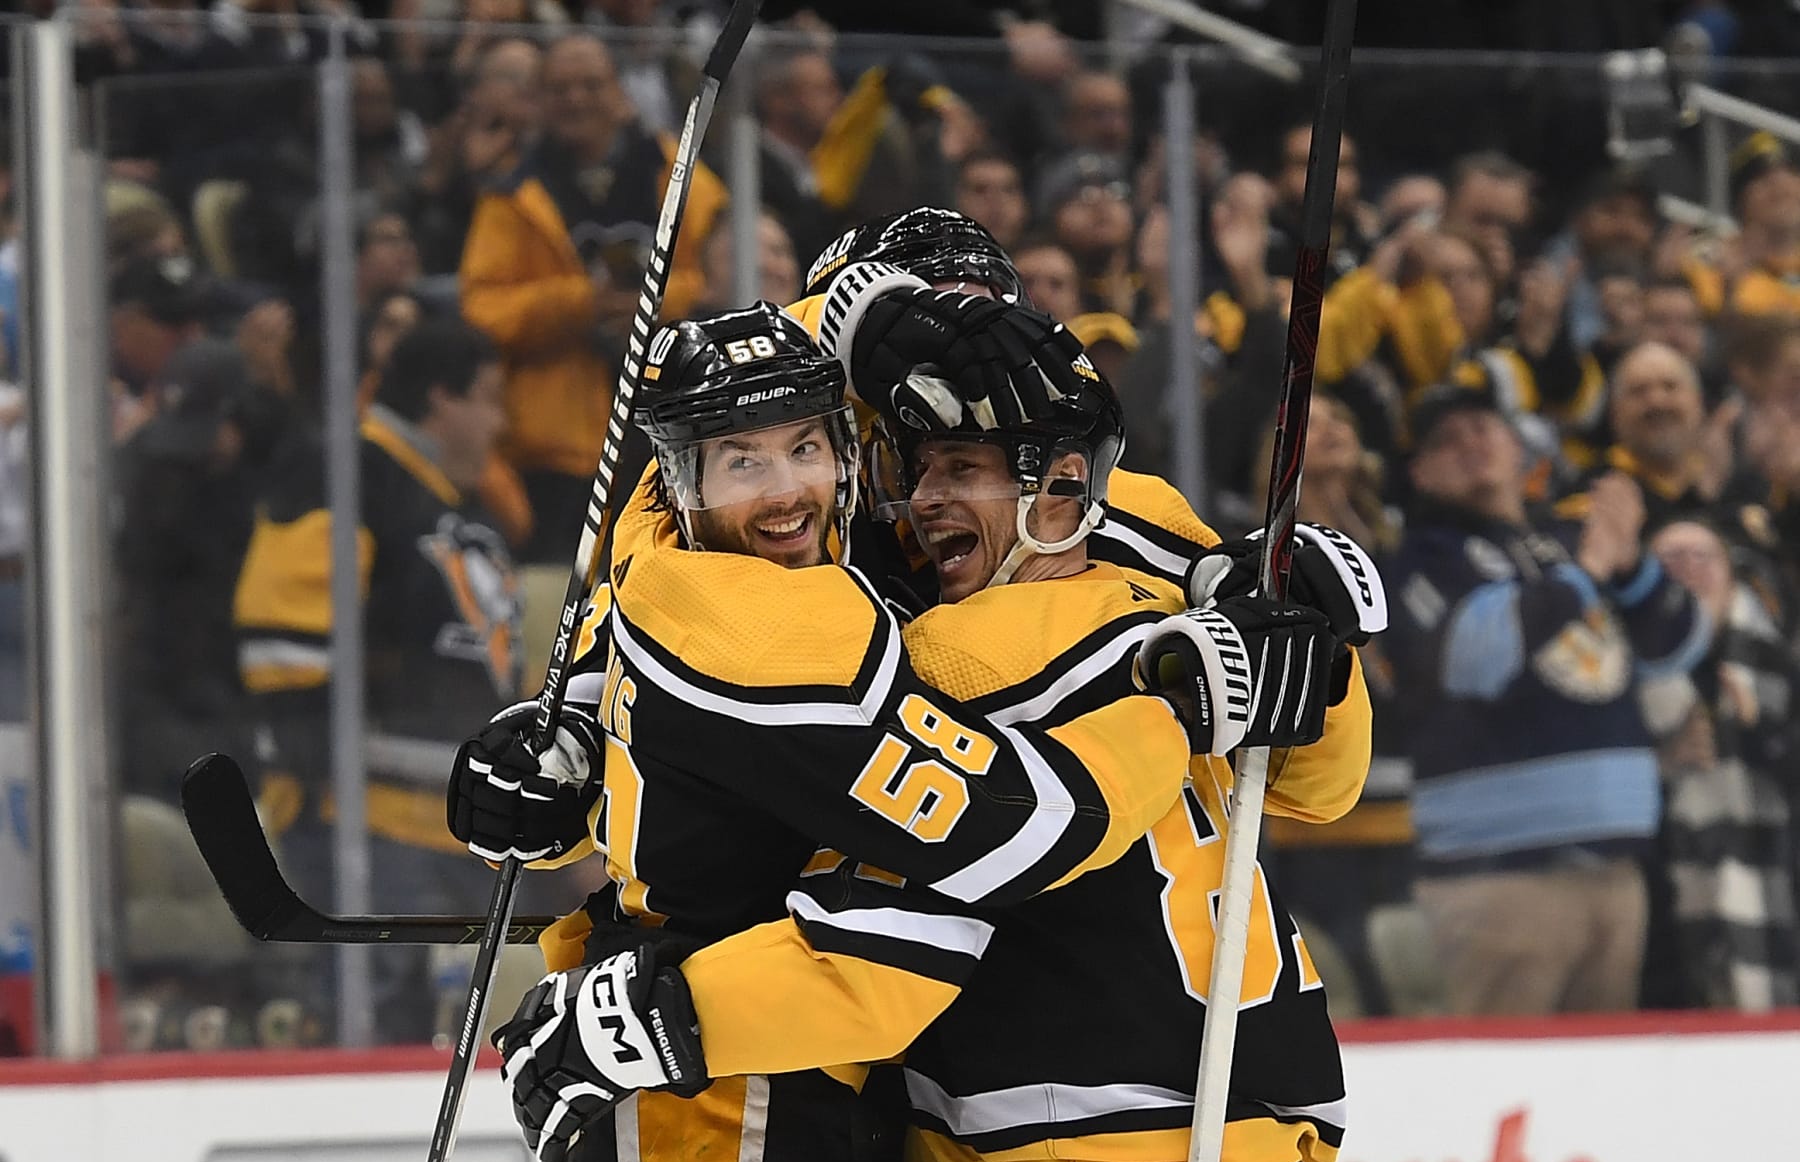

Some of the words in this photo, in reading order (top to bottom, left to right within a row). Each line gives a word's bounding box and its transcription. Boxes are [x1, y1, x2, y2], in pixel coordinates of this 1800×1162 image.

[725, 335, 777, 364] 58
[736, 386, 796, 407] BAUER
[848, 693, 999, 843] 58
[457, 987, 481, 1059] WARRIOR
[649, 1007, 682, 1081] PENGUINS
